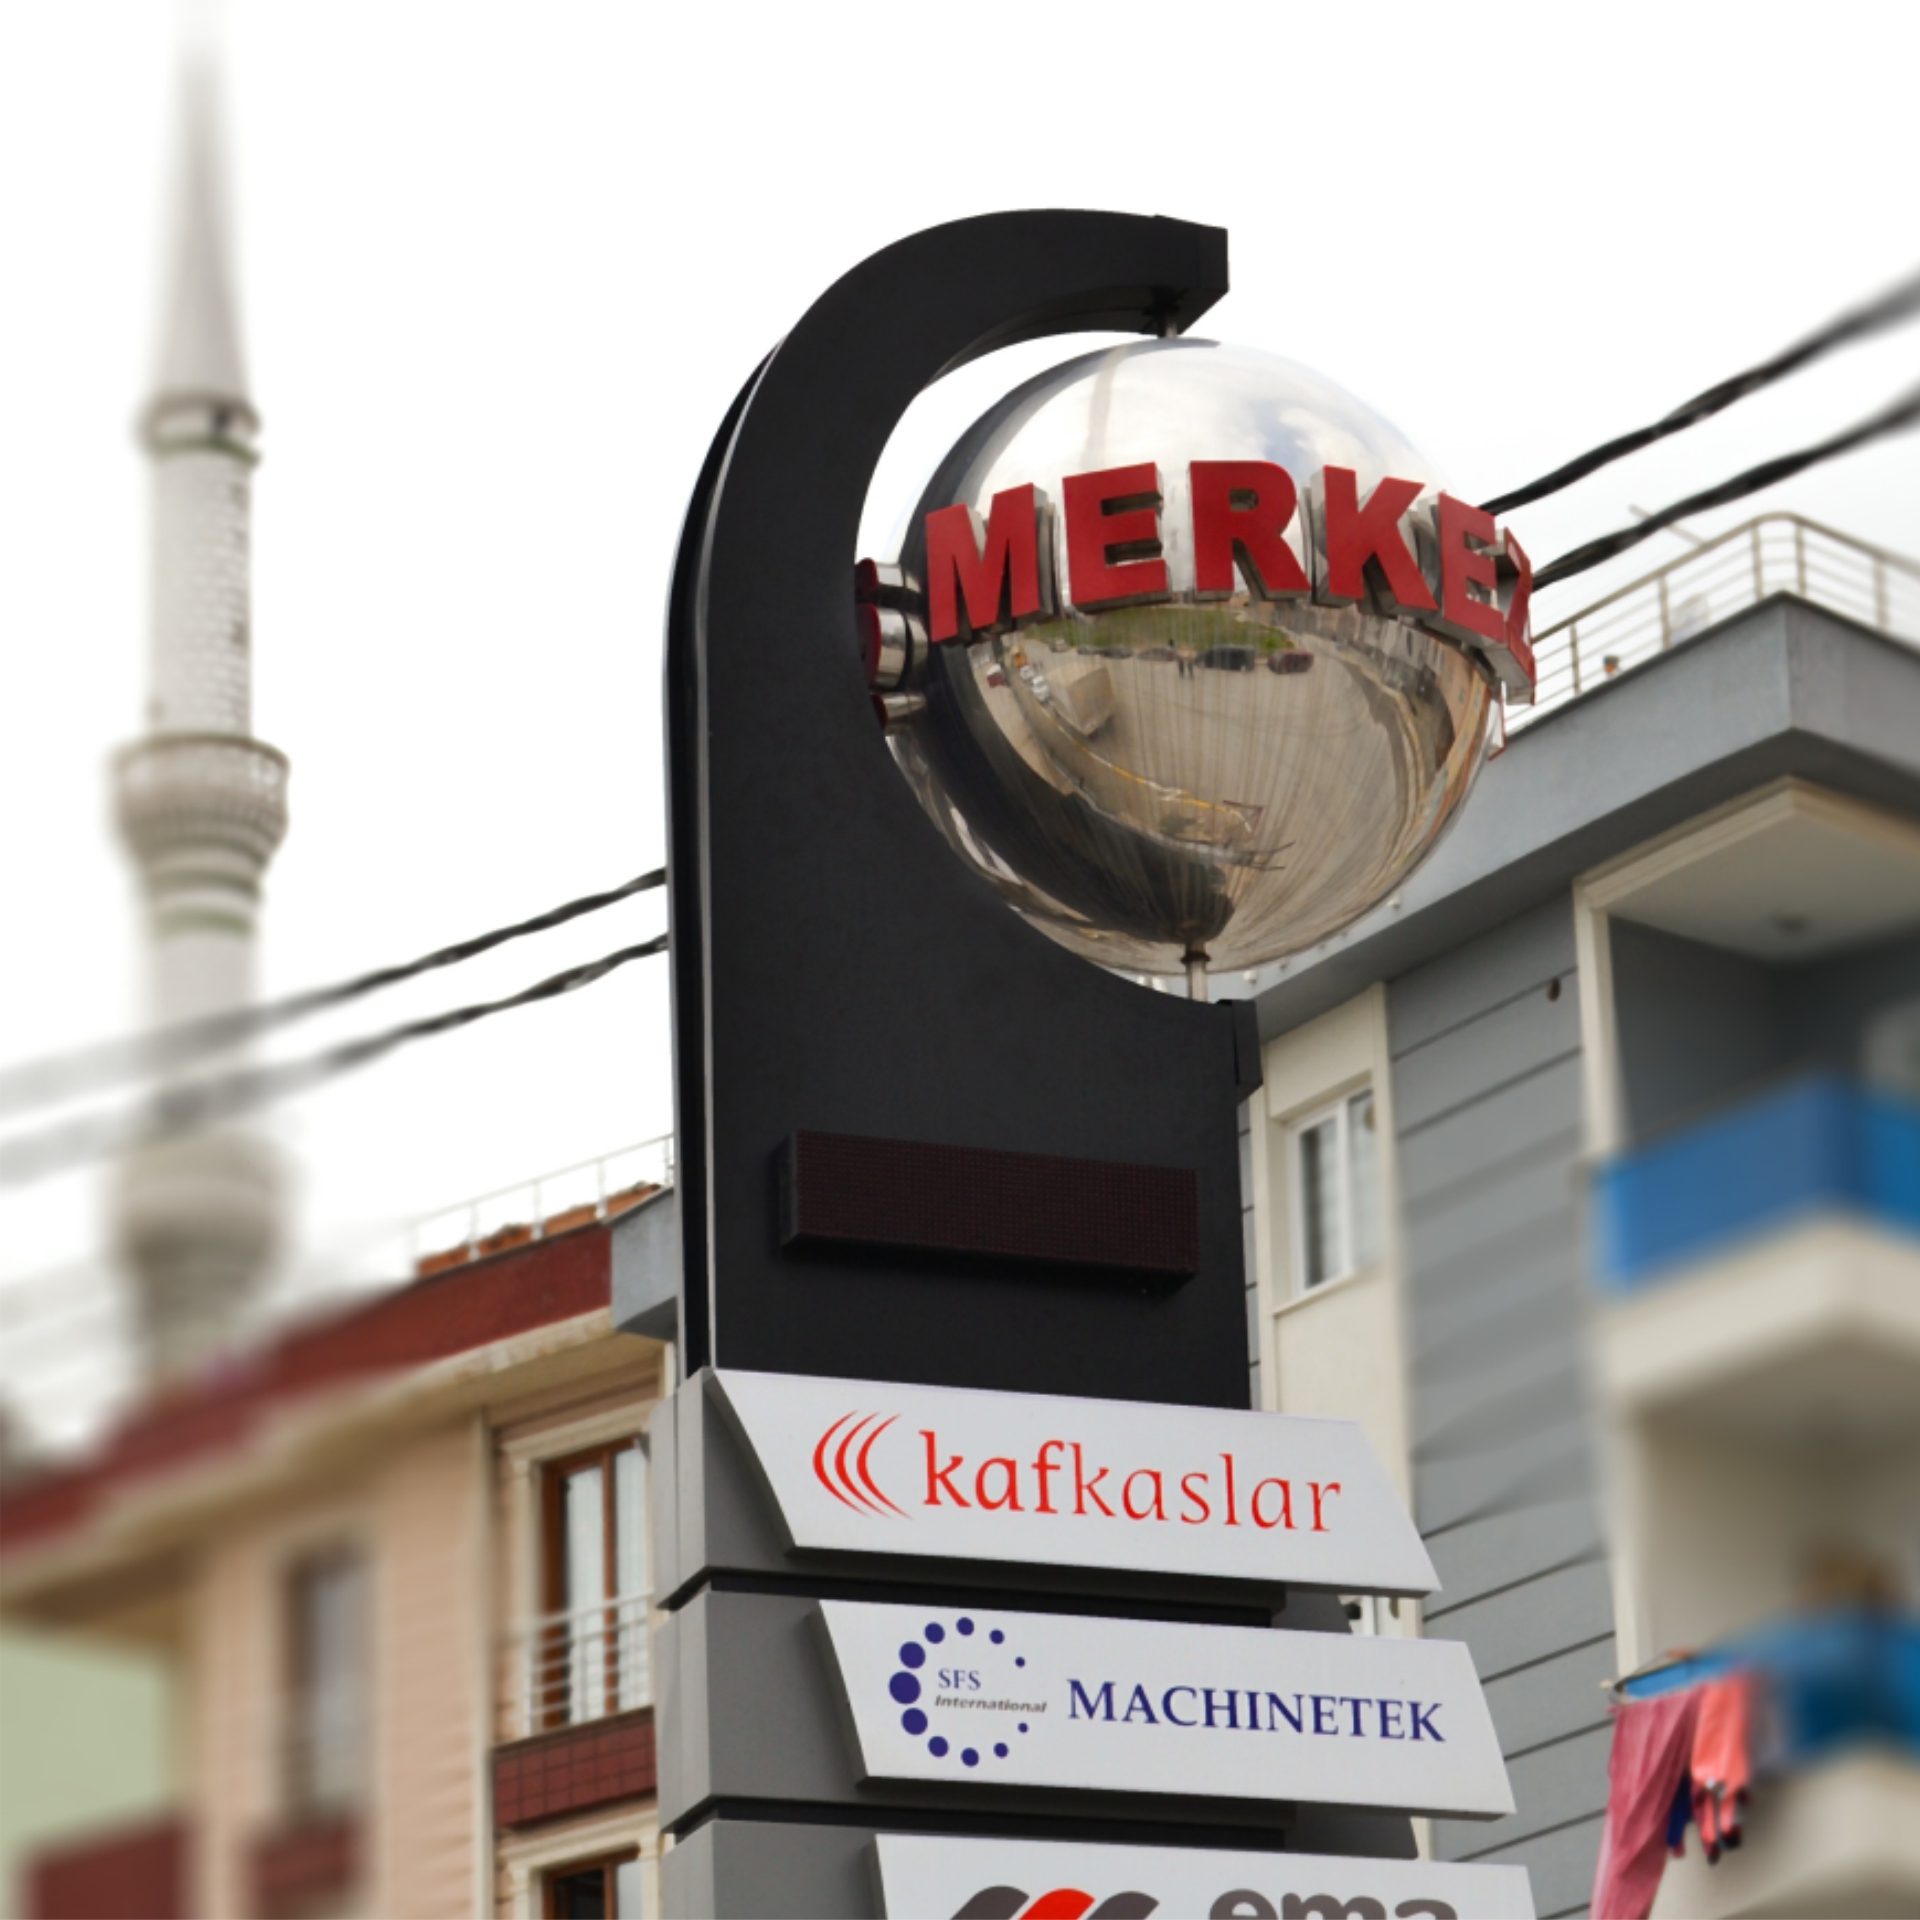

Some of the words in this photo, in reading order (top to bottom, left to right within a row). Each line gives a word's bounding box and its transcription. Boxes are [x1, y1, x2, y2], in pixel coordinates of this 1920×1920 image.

[918, 1430, 1342, 1533] kafkaslar
[938, 1668, 981, 1691] SFS
[935, 1694, 1048, 1713] International
[1067, 1679, 1445, 1742] MACHINETEK
